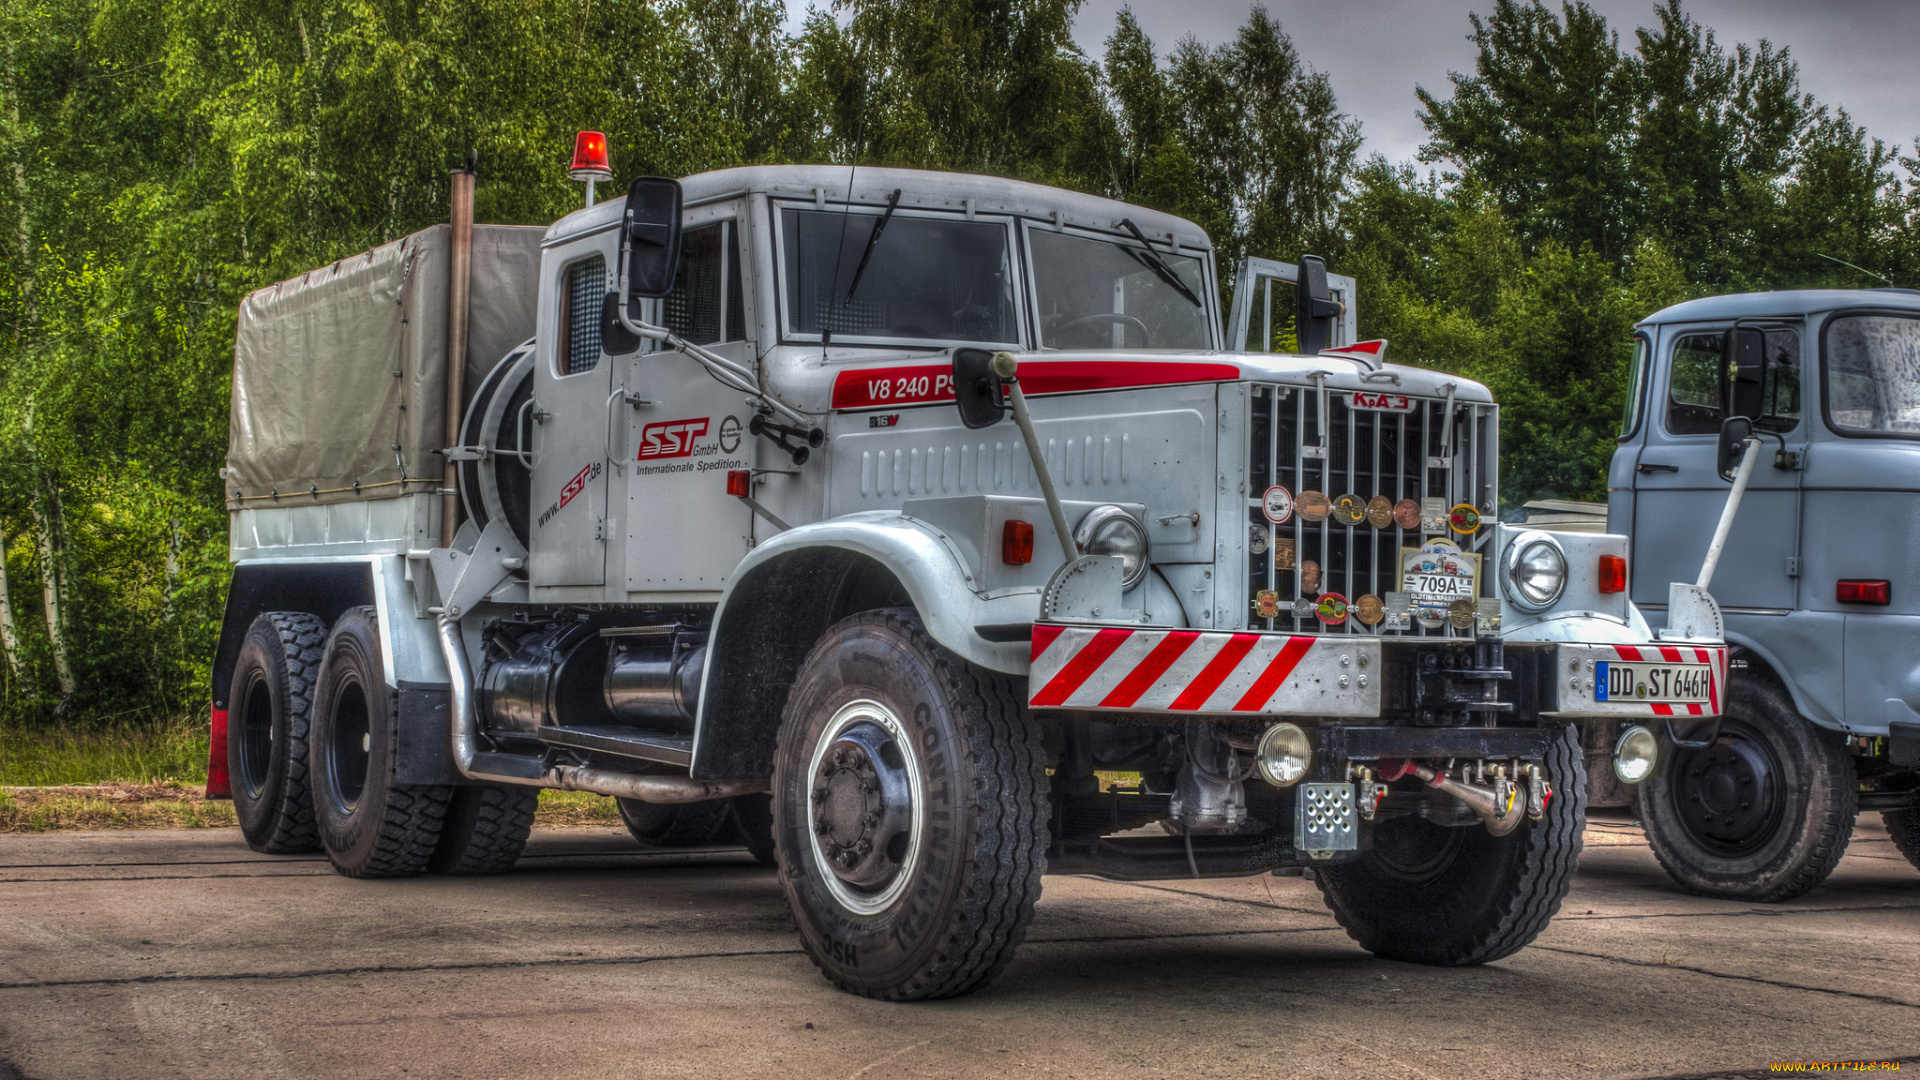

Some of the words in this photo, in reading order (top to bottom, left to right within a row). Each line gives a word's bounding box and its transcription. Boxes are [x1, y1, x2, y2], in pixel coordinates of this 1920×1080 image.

[868, 379, 891, 400] V8
[895, 376, 929, 398] 240
[876, 414, 899, 427] 16V
[641, 423, 705, 456] SST
[692, 443, 719, 457] GmbH
[636, 463, 694, 476] Internationale
[696, 458, 741, 474] Spedition
[1419, 575, 1458, 594] 709A
[1599, 685, 1605, 694] D
[1609, 667, 1634, 696] DD
[1649, 668, 1671, 697] ST
[1674, 669, 1709, 698] 646H
